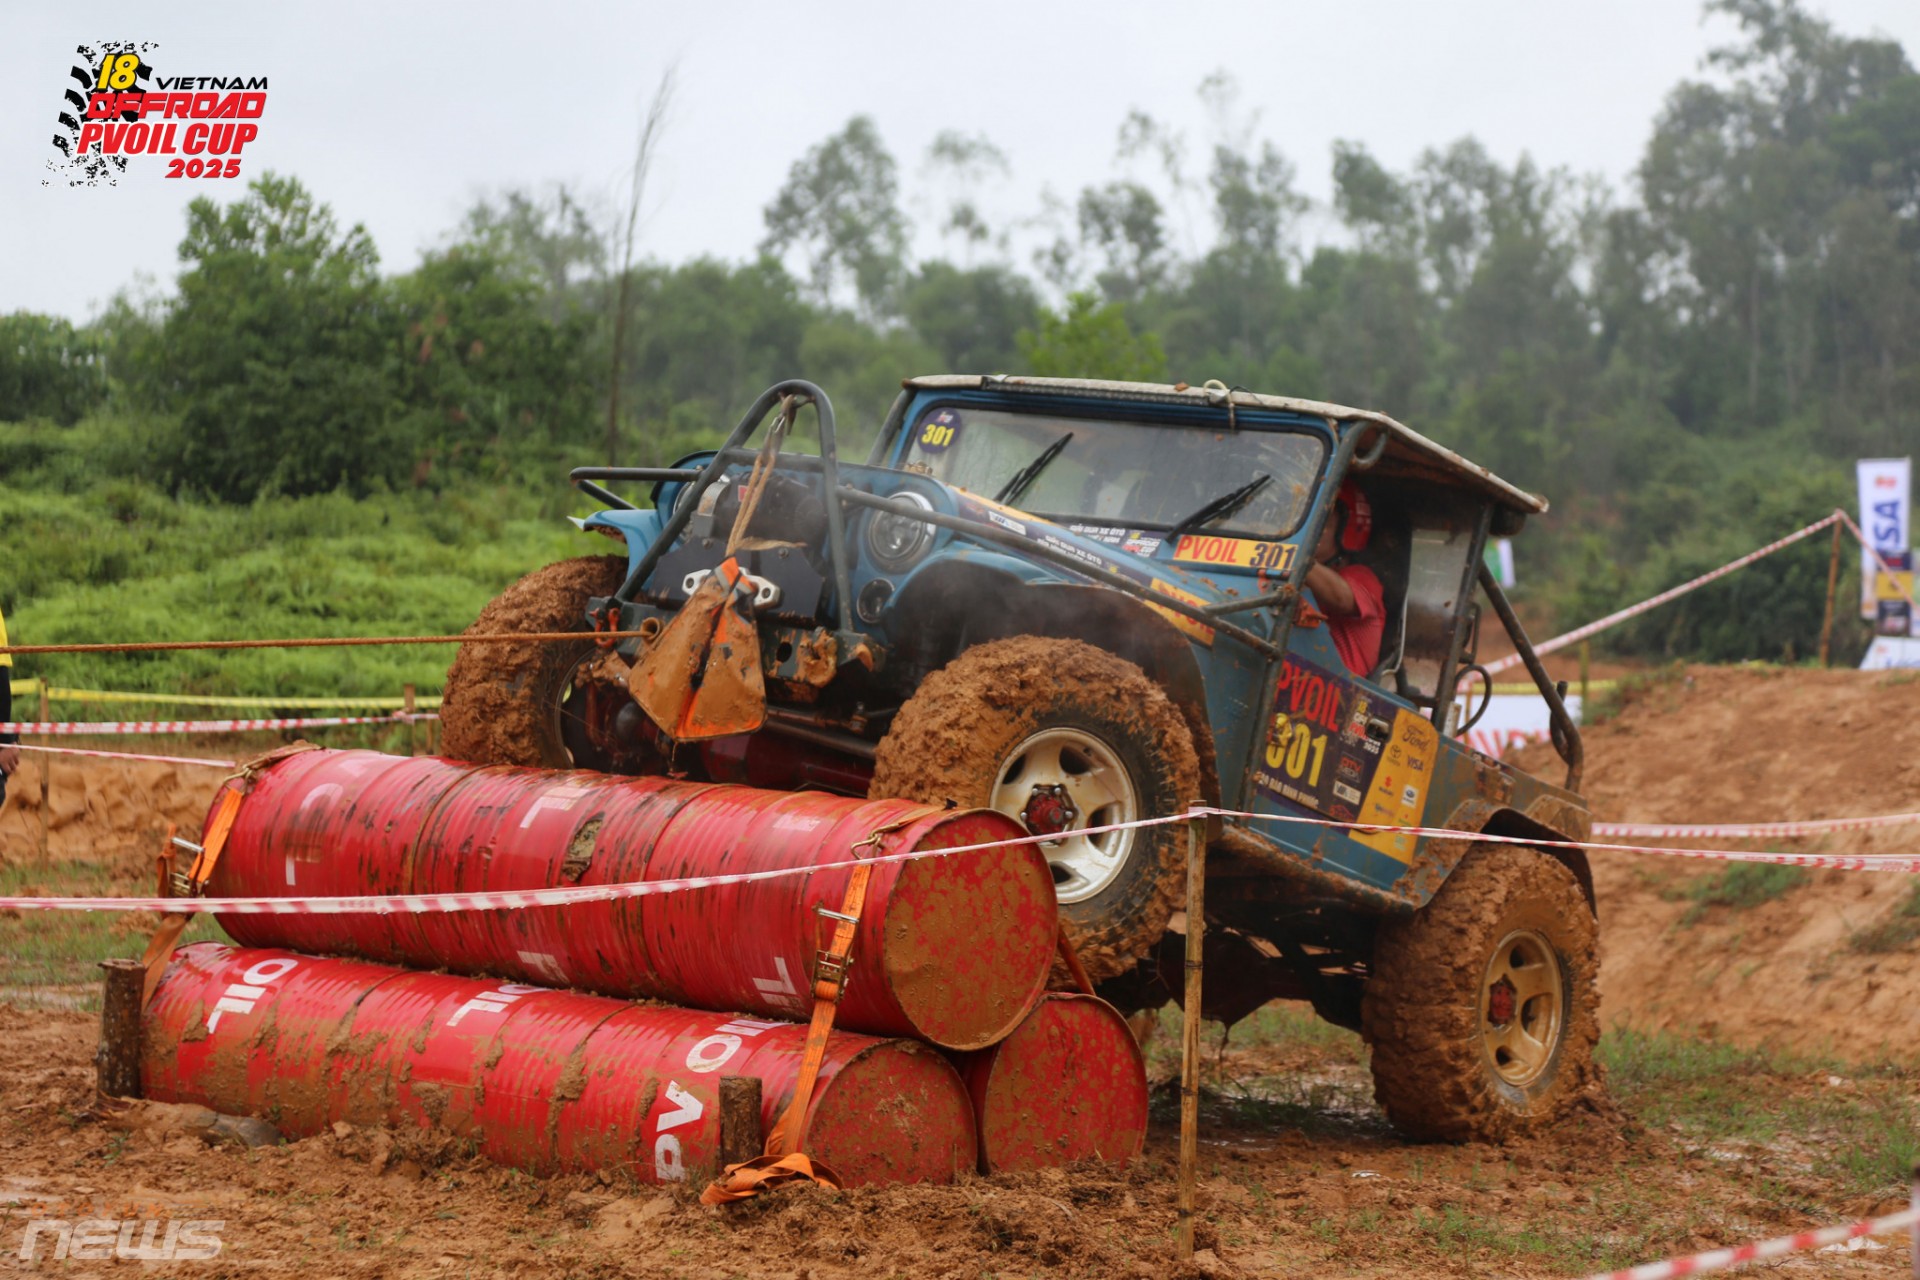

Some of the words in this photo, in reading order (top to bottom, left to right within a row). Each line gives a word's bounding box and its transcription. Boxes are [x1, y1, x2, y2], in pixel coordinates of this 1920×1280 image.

[921, 423, 955, 447] 301
[1174, 535, 1240, 563] PVOIL
[1249, 543, 1297, 570] 301
[1274, 659, 1341, 733] PVOIL
[1407, 755, 1425, 772] VISA
